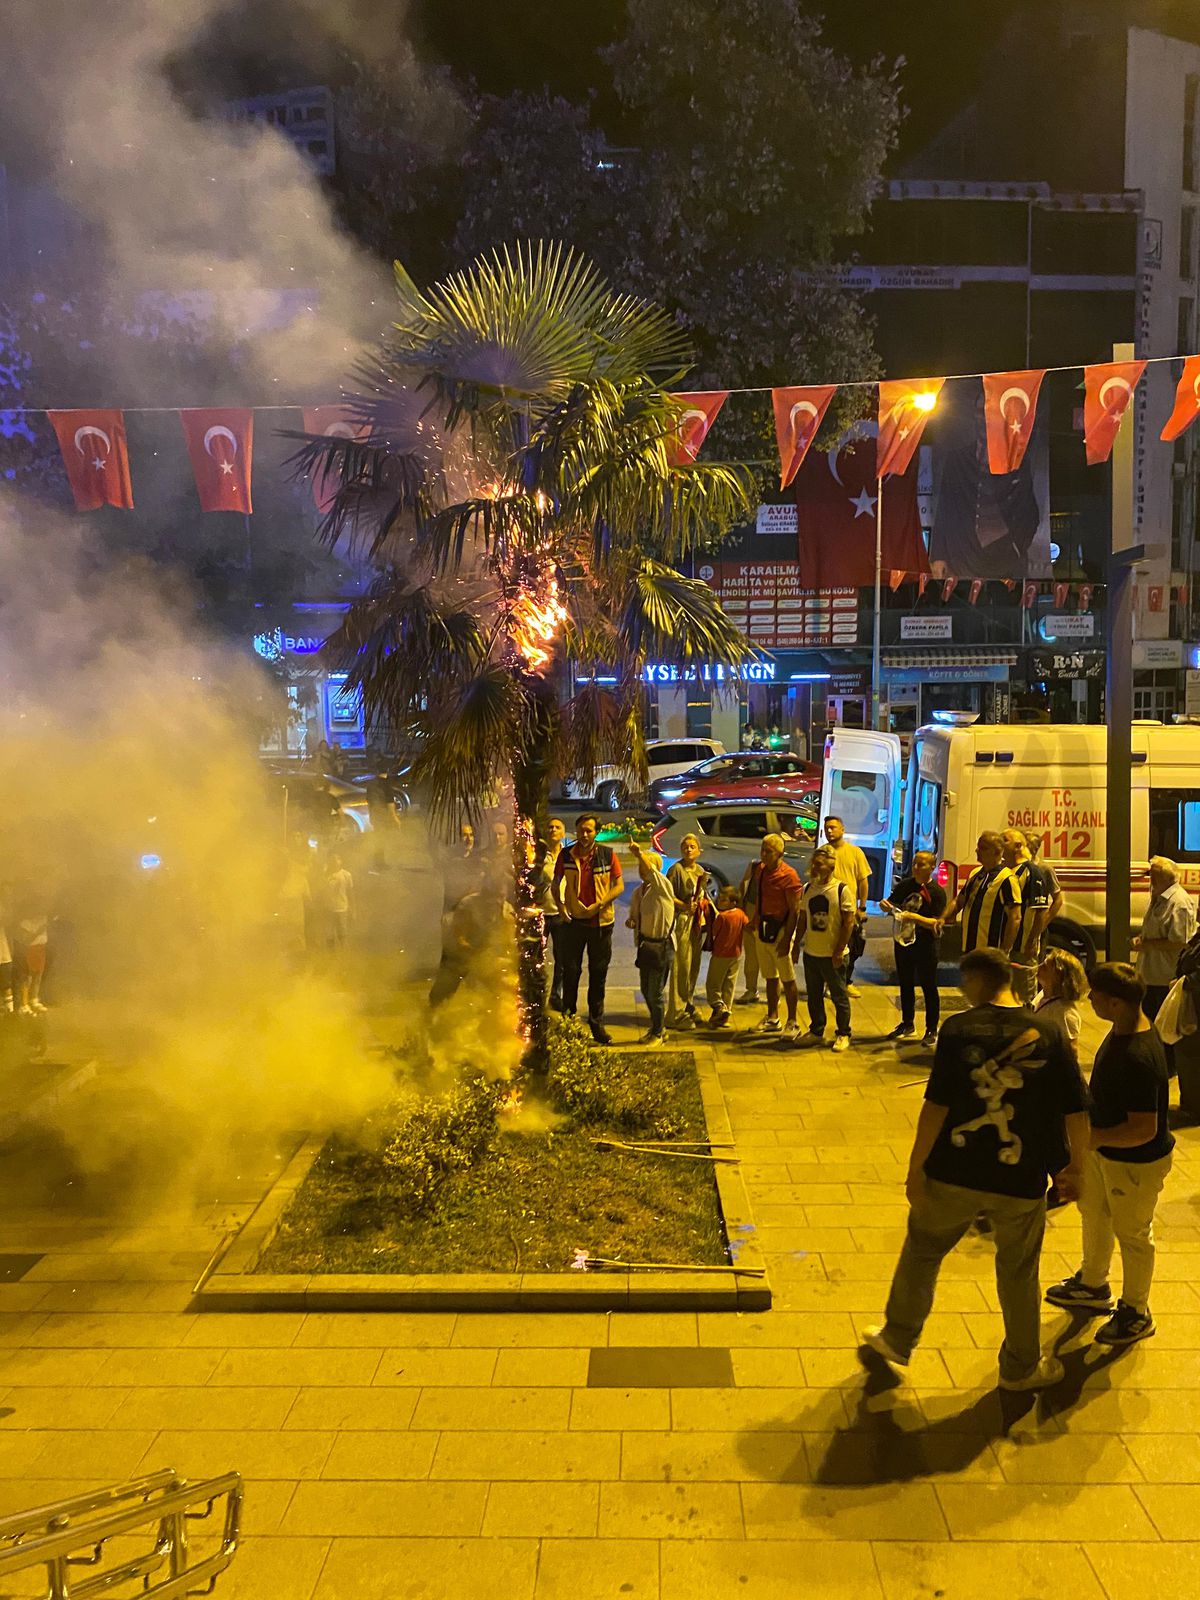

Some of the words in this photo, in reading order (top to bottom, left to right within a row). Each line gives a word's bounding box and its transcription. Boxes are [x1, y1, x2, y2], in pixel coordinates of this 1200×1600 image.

[777, 577, 799, 586] KAD
[1051, 789, 1077, 807] T.C.
[1007, 807, 1050, 828] SAĞLIK
[1054, 810, 1108, 828] BAKANL
[1041, 830, 1091, 858] 112
